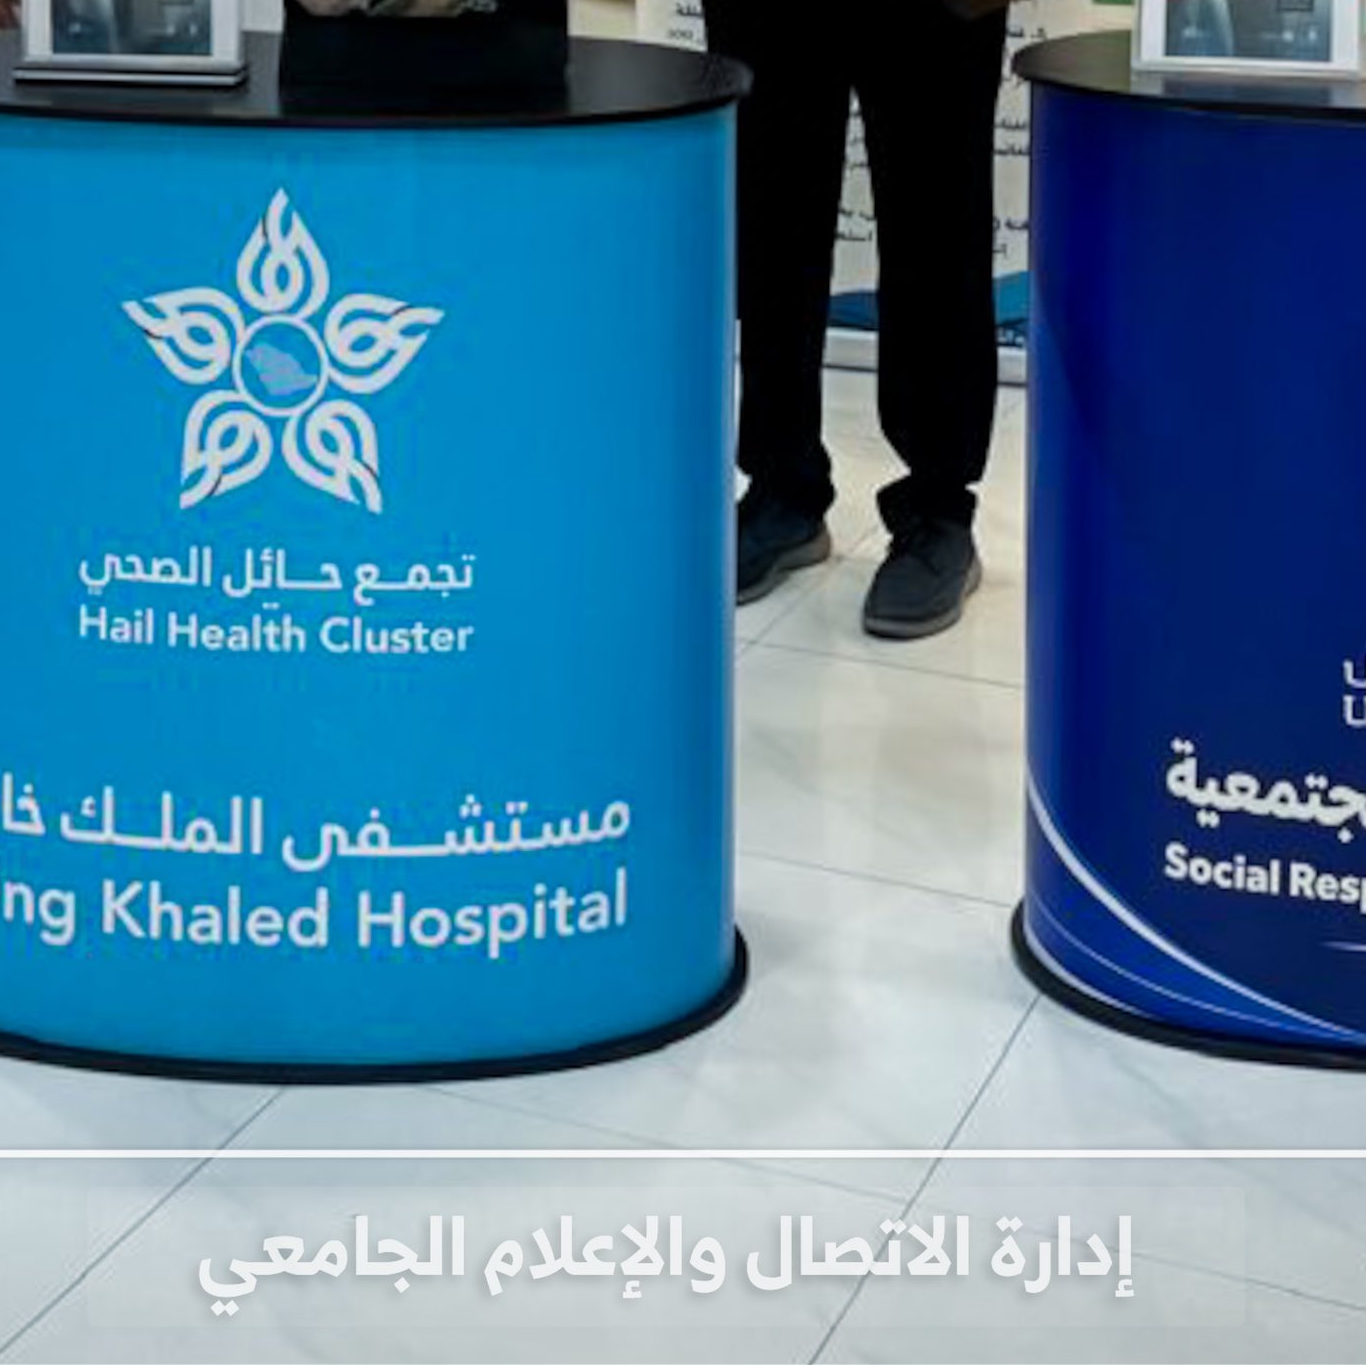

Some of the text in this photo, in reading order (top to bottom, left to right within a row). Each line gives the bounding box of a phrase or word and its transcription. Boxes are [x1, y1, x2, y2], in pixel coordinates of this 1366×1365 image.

[77, 545, 476, 605] تجمع حائل الصحي
[78, 604, 475, 655] Hail Health Cluster
[61, 785, 264, 856] الملك
[281, 793, 631, 872] مستشفى
[1163, 843, 1282, 894] Social
[101, 878, 331, 949] Khaled
[358, 866, 629, 959] Hospital
